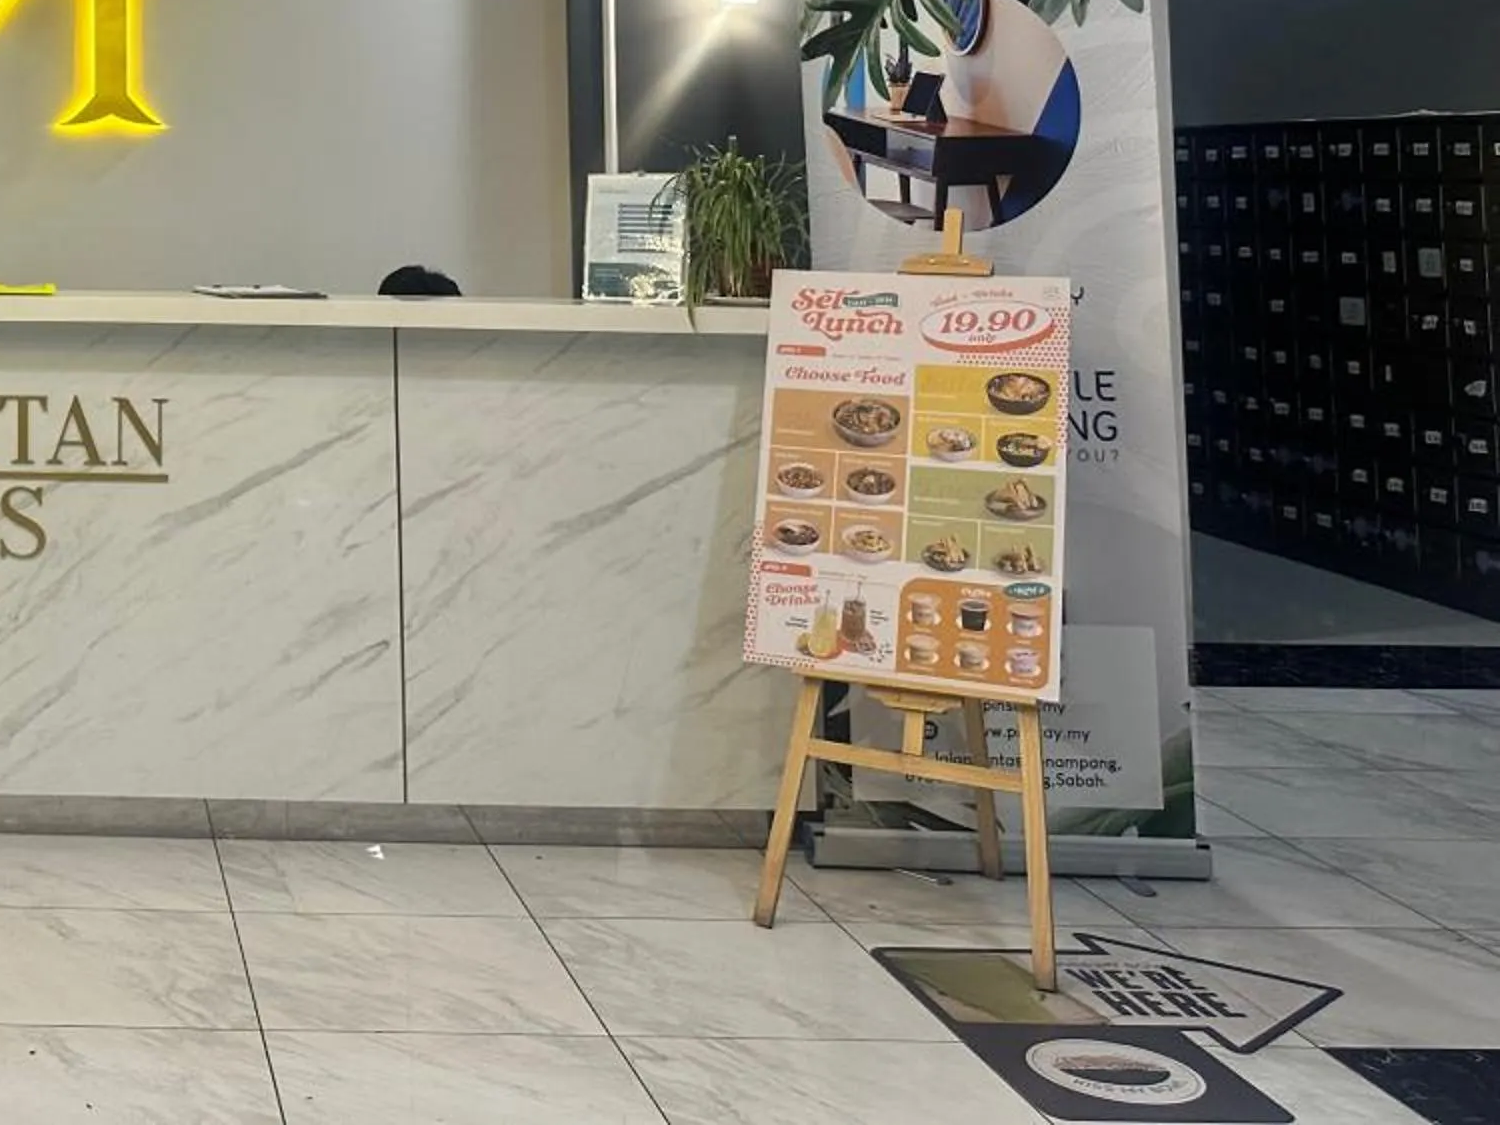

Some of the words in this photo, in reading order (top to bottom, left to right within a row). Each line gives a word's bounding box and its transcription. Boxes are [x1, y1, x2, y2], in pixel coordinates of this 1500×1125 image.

[791, 288, 859, 310] Set
[802, 310, 903, 341] Lunch
[940, 308, 1037, 333] 19.90
[785, 366, 851, 383] Choose
[1073, 370, 1117, 402] LE
[1068, 410, 1118, 442] NG
[1068, 448, 1119, 462] OU?
[1043, 759, 1123, 773] nampang,
[1064, 966, 1208, 990] WE'RE
[1092, 990, 1248, 1018] HERE
